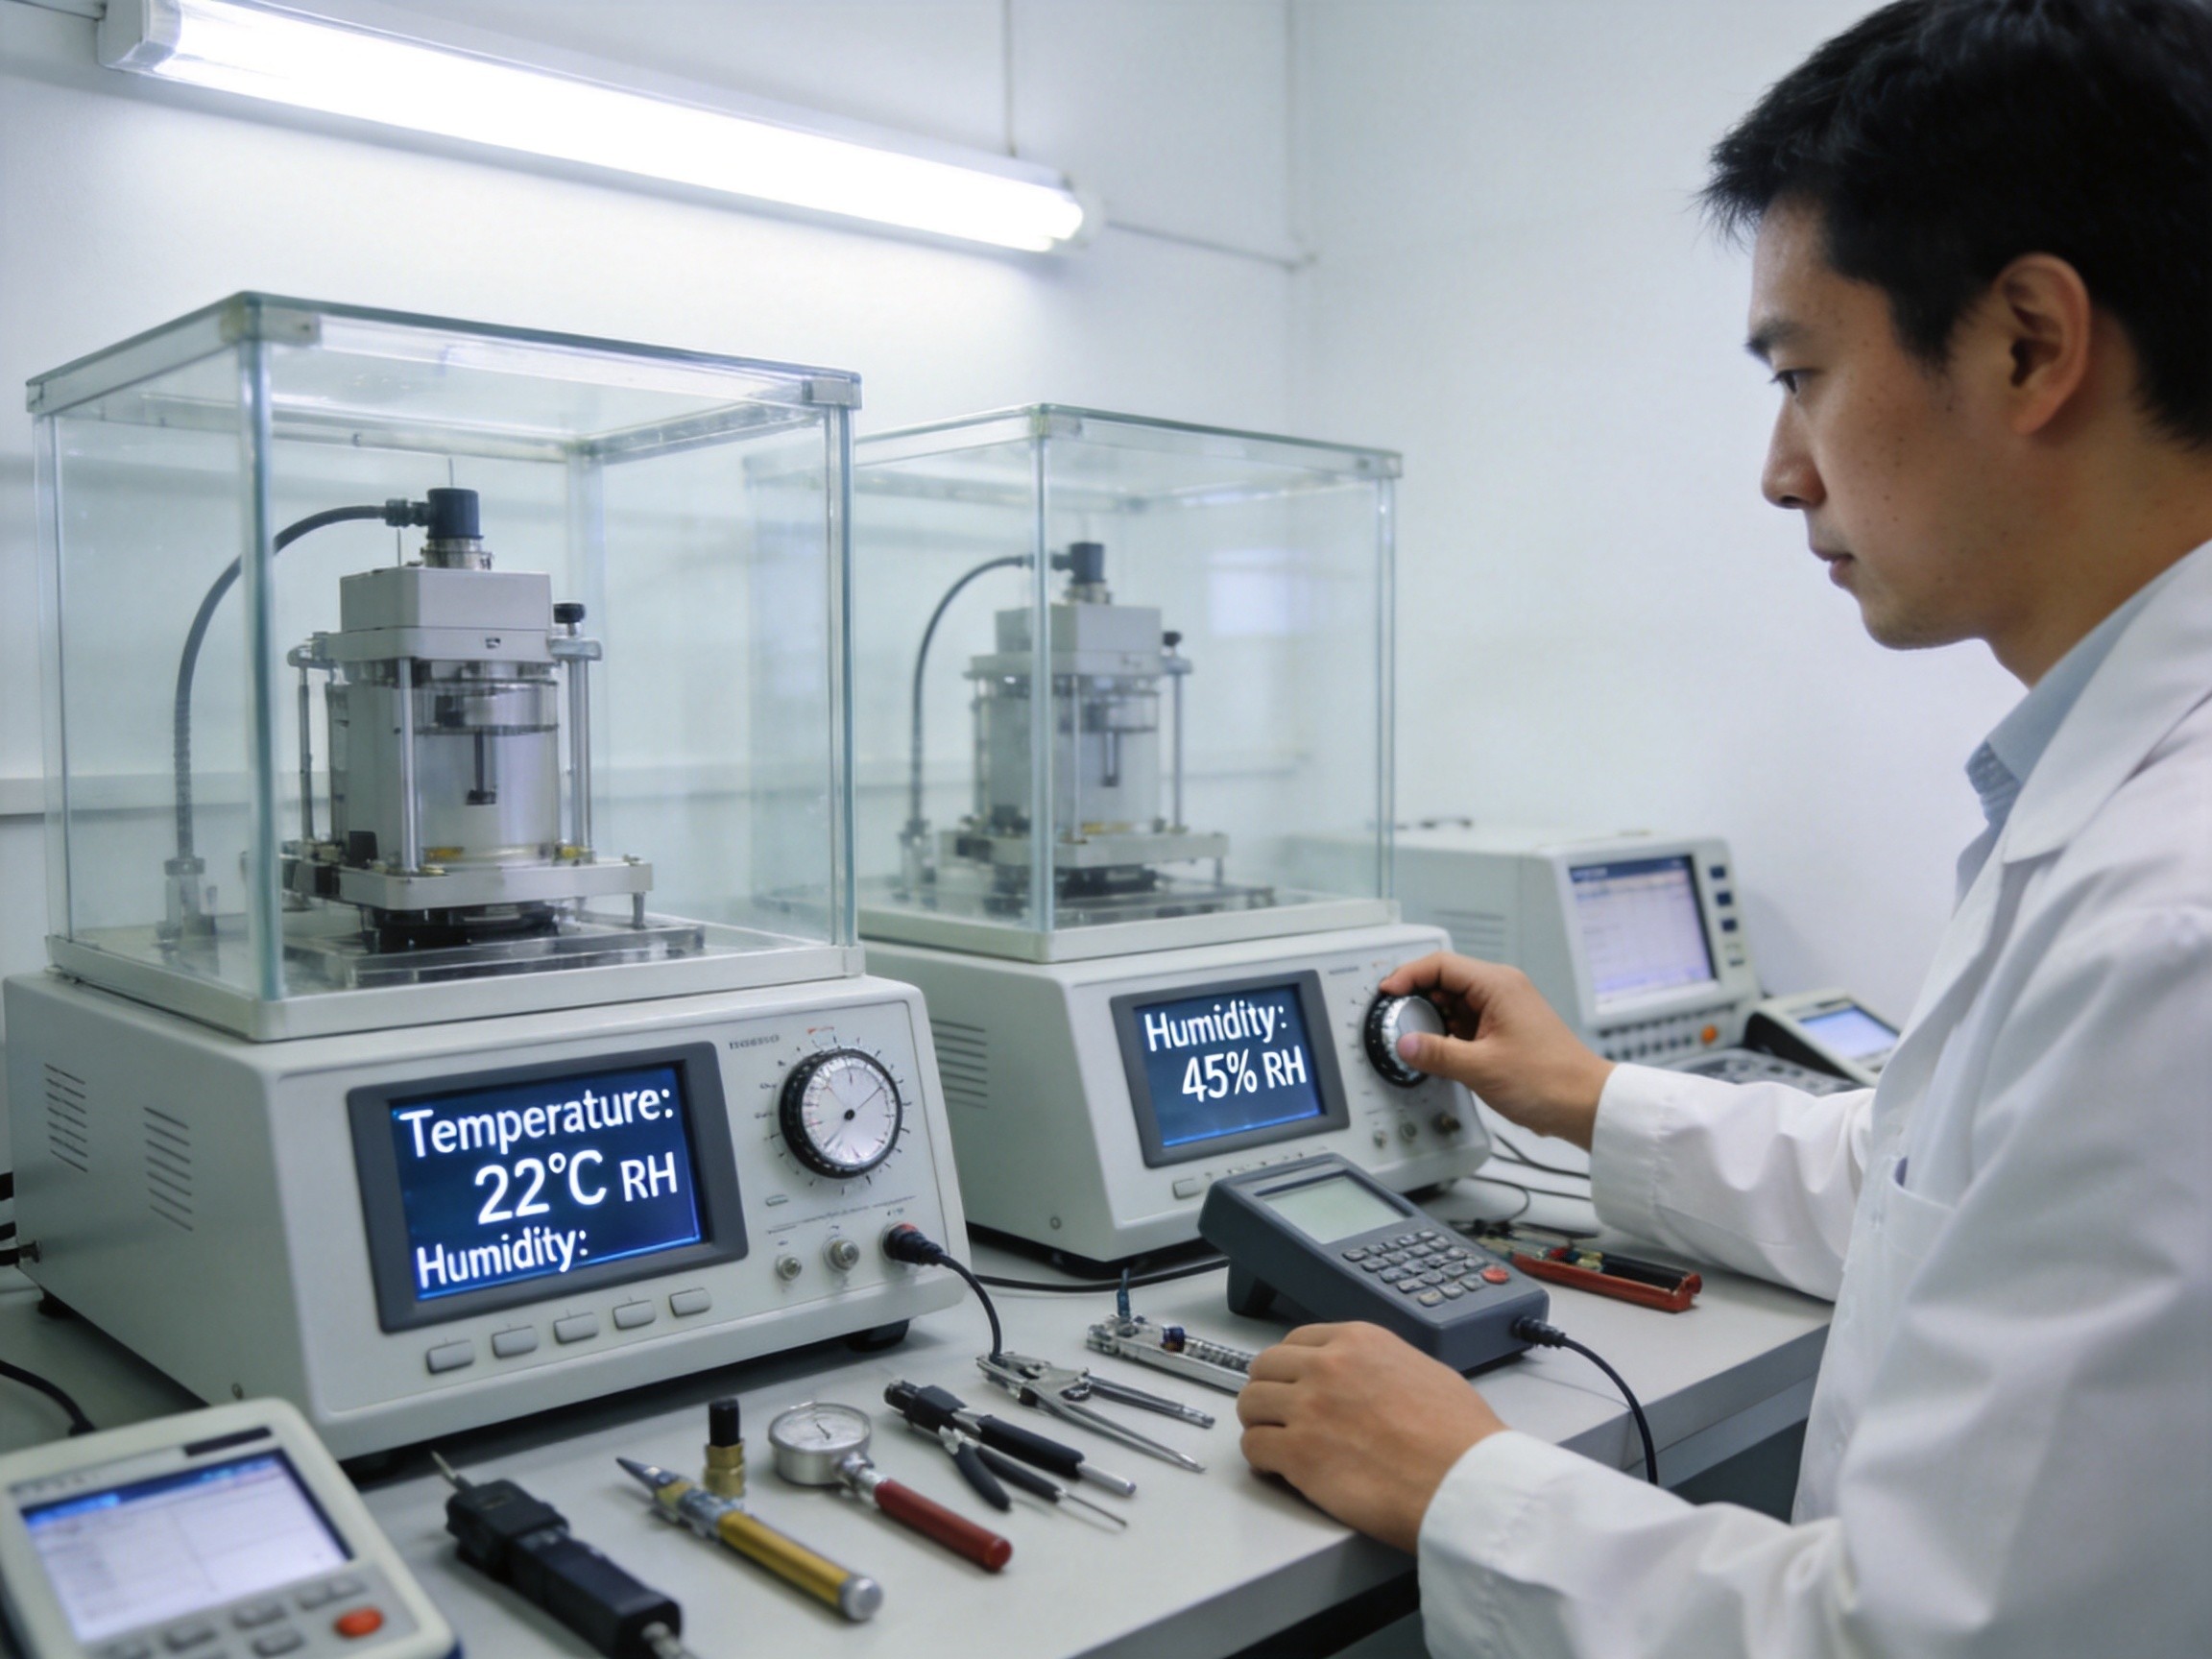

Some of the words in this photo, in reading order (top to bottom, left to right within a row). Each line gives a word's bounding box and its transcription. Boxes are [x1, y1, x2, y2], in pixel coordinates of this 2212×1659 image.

[1144, 999, 1287, 1052] Humidity:
[1182, 1049, 1258, 1102] 45%
[1263, 1046, 1307, 1089] RH
[398, 1088, 674, 1158] Temperature:
[474, 1150, 607, 1224] 22°C
[622, 1152, 678, 1202] RH
[418, 1228, 588, 1288] Humidity:
